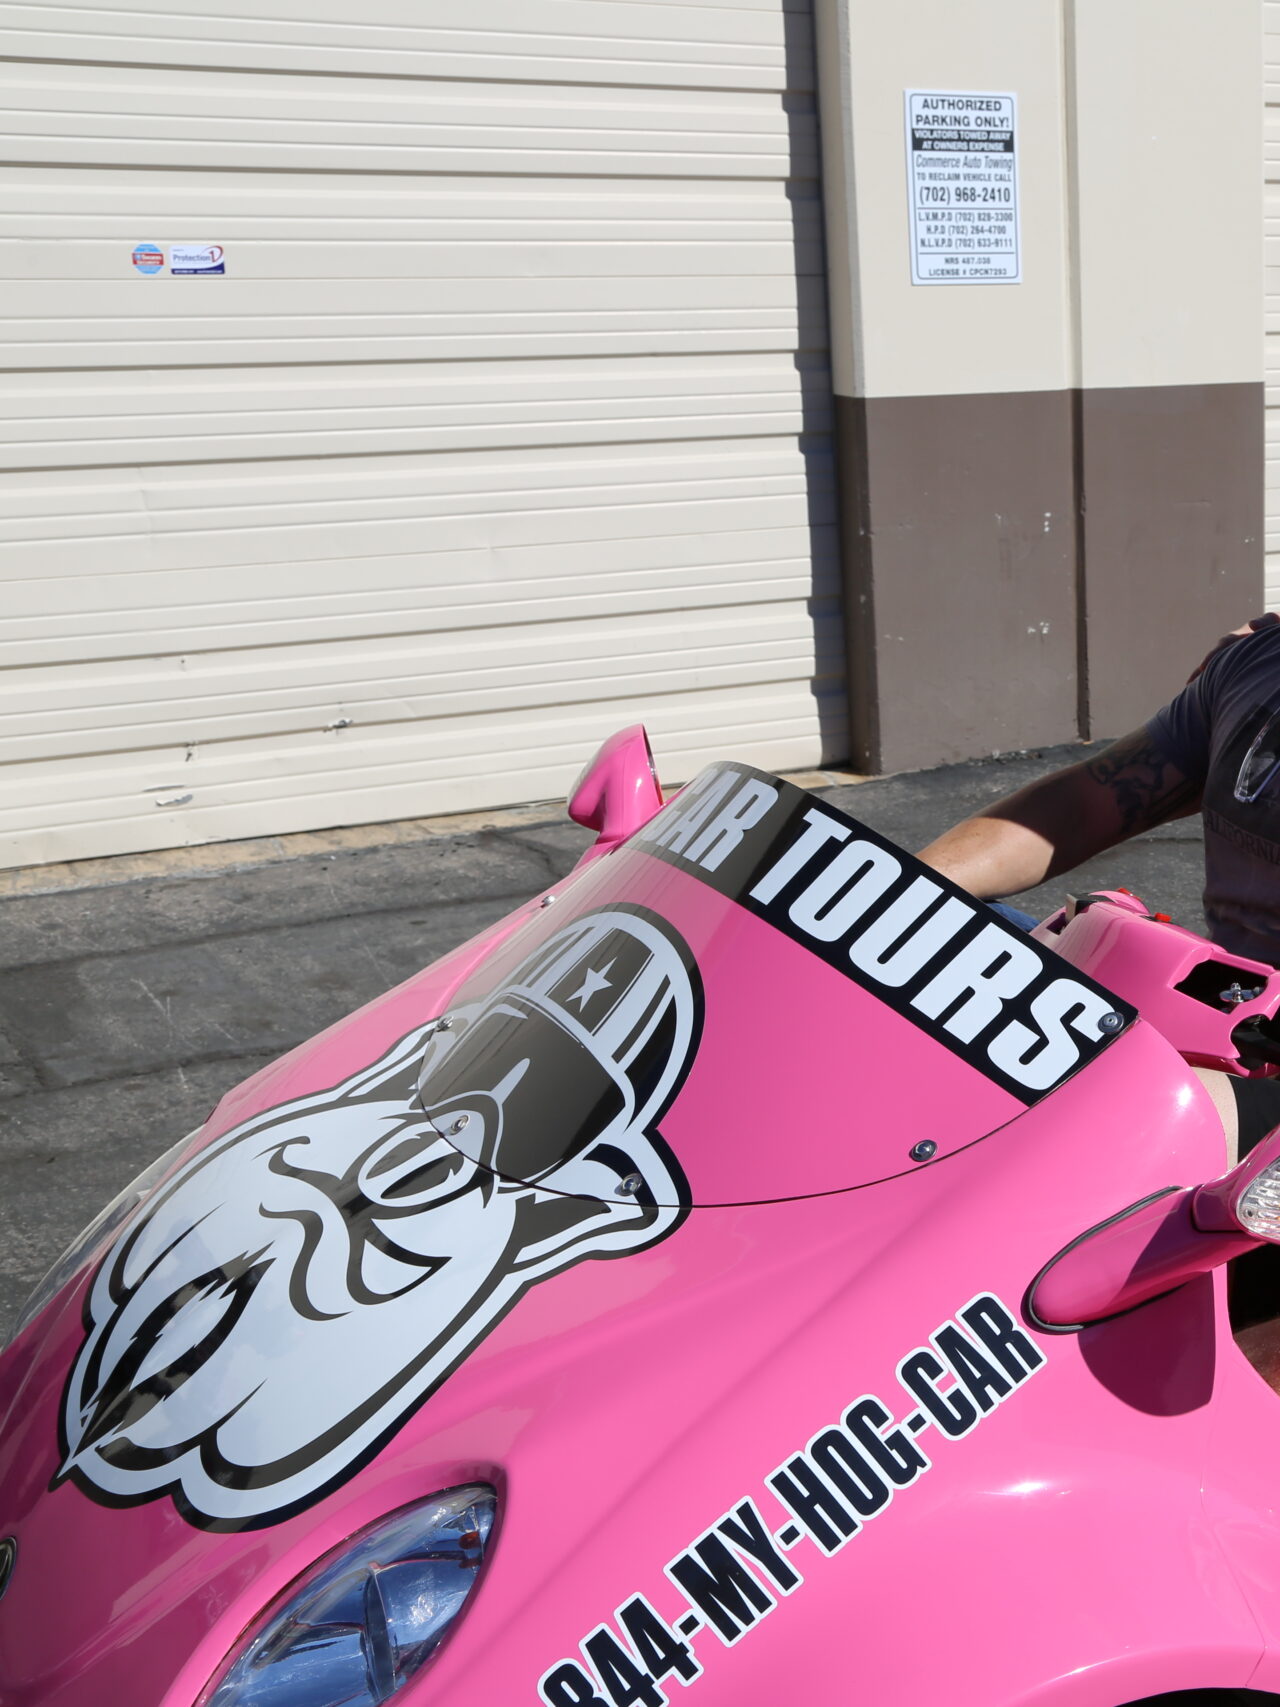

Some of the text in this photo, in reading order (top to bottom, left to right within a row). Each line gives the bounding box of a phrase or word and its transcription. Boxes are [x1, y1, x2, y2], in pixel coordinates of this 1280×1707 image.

[922, 98, 1002, 111] AUTHORIZED
[915, 114, 1010, 128] PARKING ONLY!
[914, 130, 1011, 140] VIOLATORS TOWED AWAY
[922, 141, 1005, 151] AT OWNERS EXPENSE
[916, 154, 1012, 172] Commerce Auto Towing
[916, 172, 1012, 182] TO RECLAIM VEHICLE CALL
[919, 185, 1010, 205] (702) 968-2410
[955, 212, 975, 223] (702)
[948, 225, 968, 236] (702)
[955, 238, 975, 249] (702)
[173, 253, 210, 263] Protection
[640, 768, 1117, 1091] CAR TOURS
